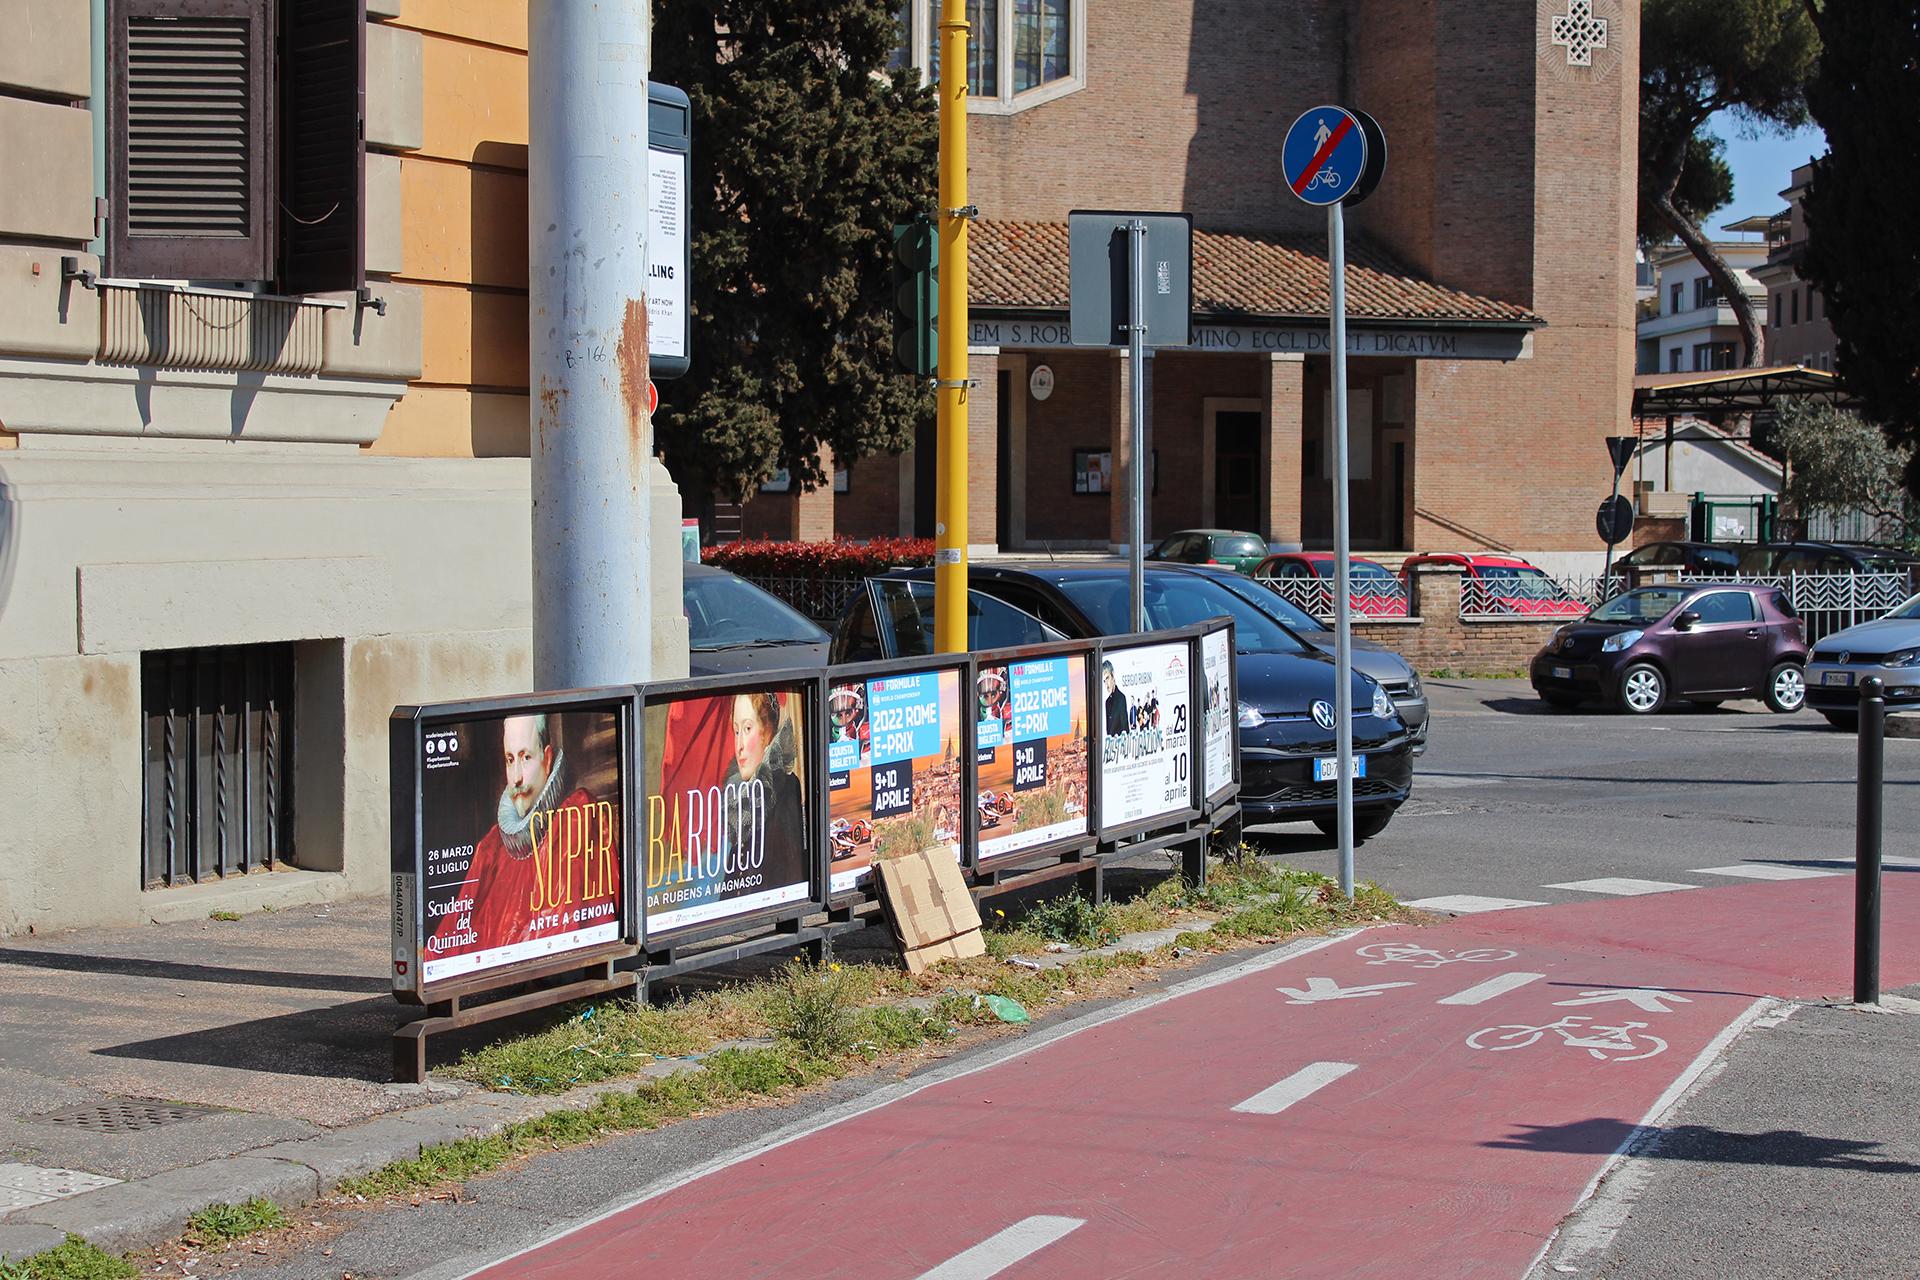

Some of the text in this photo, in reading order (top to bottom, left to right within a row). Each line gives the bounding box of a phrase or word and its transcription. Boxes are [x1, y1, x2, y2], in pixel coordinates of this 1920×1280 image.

[649, 264, 674, 279] LING
[968, 323, 1000, 342] EM
[1375, 333, 1457, 353] DICATVM
[886, 677, 914, 691] FORMULA
[915, 676, 921, 687] E
[1014, 686, 1068, 714] 2022 ROME
[872, 702, 937, 733] 2022 ROME
[1015, 711, 1049, 736] E-PRIX
[1173, 703, 1187, 734] 29
[873, 730, 914, 758] E-PRIX
[1165, 734, 1187, 750] marzo
[1015, 746, 1035, 766] 9+10
[875, 769, 897, 791] 9+10
[1016, 763, 1045, 785] APRILE
[1164, 771, 1171, 786] al
[1172, 752, 1187, 783] 10
[875, 787, 910, 812] APRILE
[1164, 784, 1187, 803] aprile
[647, 778, 765, 889] BAROCCO
[428, 844, 474, 861] 26 MARZO
[529, 801, 615, 912] SUPER
[428, 860, 469, 876] 3 LUGLIO
[646, 874, 763, 908] DA RUBENS A MAGNASCO
[427, 894, 474, 918] Scuderie
[528, 902, 615, 932] ARTE A GENOVA
[456, 911, 472, 931] del
[427, 927, 478, 954] Quirinale
